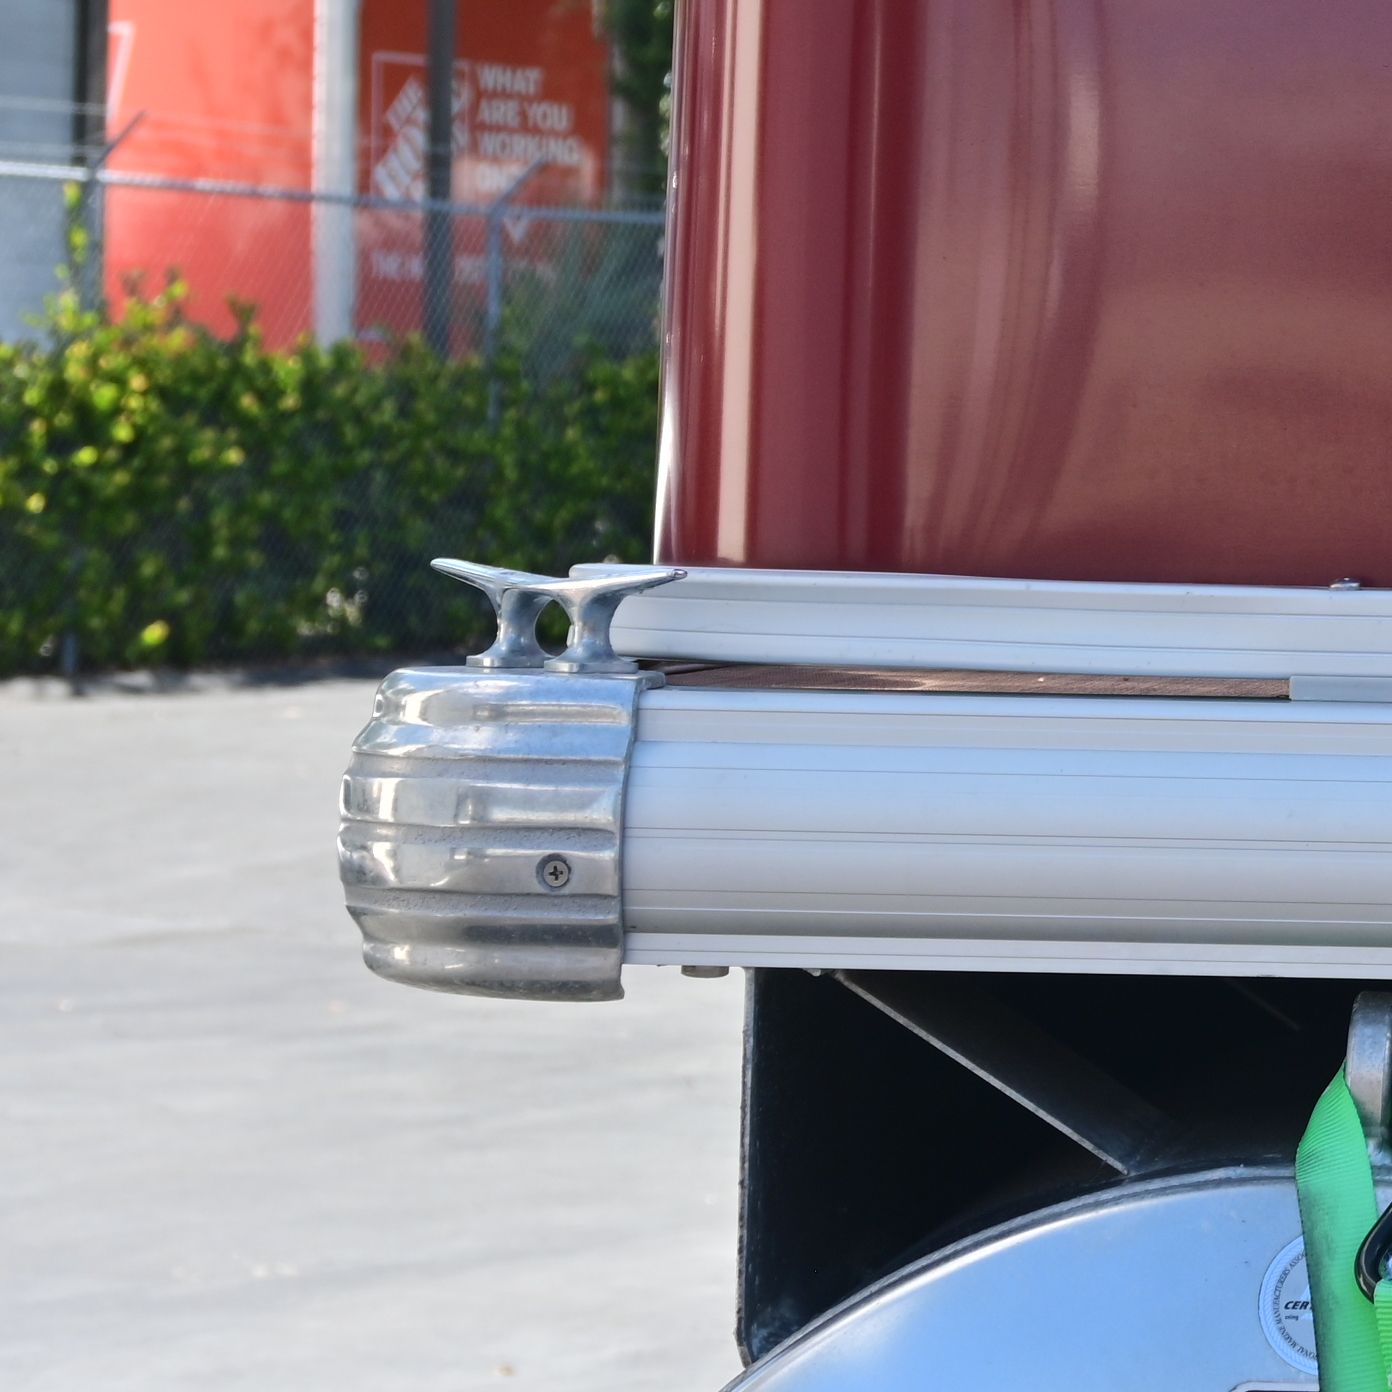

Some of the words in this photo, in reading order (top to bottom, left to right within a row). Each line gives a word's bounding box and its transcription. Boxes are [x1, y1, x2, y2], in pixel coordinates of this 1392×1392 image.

[478, 64, 543, 94] WHAT
[477, 97, 521, 127] ARE
[525, 101, 572, 131] YOU
[478, 130, 585, 165] WORKING
[1284, 1301, 1312, 1310] CER
